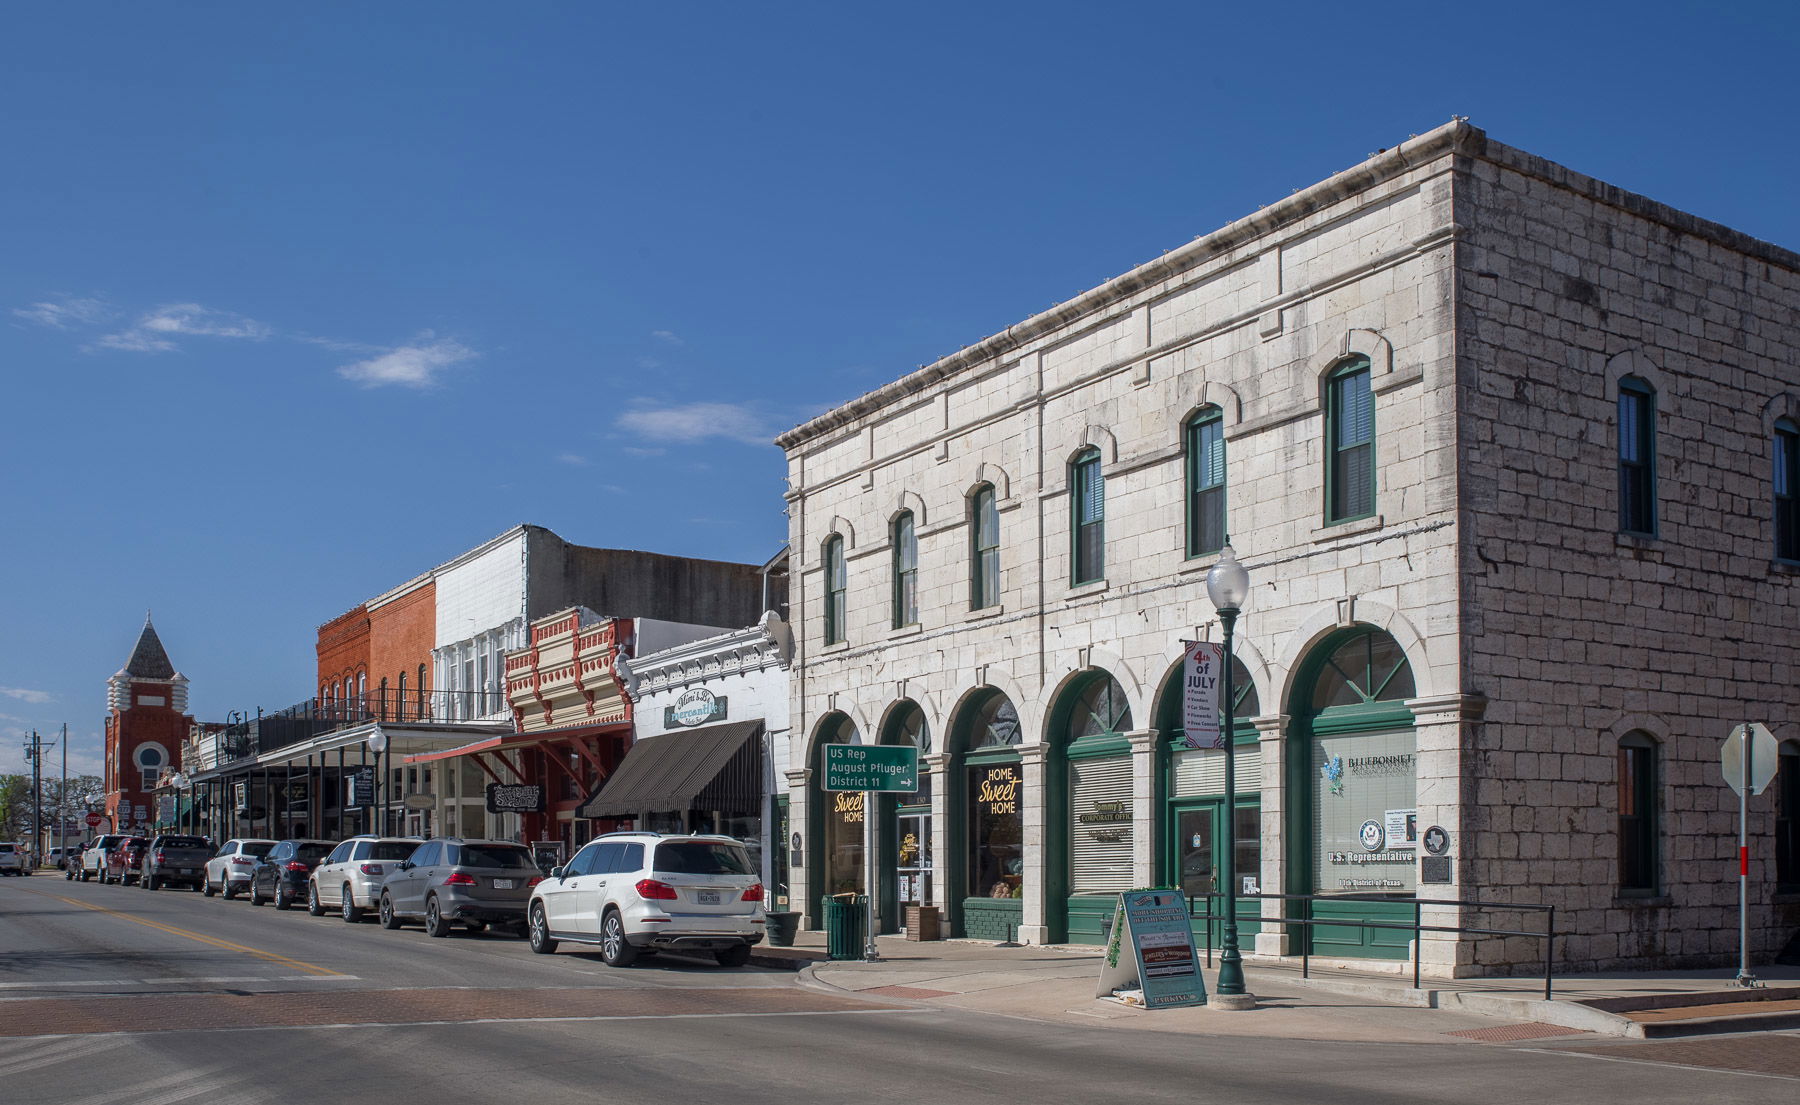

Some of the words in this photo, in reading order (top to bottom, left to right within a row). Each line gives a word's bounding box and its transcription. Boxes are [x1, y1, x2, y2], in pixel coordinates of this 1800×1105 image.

[1193, 650, 1211, 664] 4th
[1196, 663, 1209, 675] of
[1187, 675, 1216, 689] JULY
[671, 701, 718, 721] mercantile
[830, 749, 843, 758] US
[847, 749, 866, 761] Rep
[1348, 753, 1412, 768] BLUEBONNET
[830, 762, 866, 774] August
[870, 763, 906, 776] Pfluger
[988, 767, 1012, 781] HOME
[830, 776, 867, 787] District
[871, 778, 880, 787] 11
[979, 776, 1022, 802] Sweet
[834, 791, 865, 812] Sweet
[991, 802, 1015, 814] HOME
[1094, 801, 1123, 811] Tommy's
[844, 811, 863, 823] HOME
[1081, 813, 1114, 822] CORPORATE
[1114, 813, 1133, 821] OFFIC
[1328, 852, 1345, 862] U.S.
[1347, 850, 1412, 864] Representative
